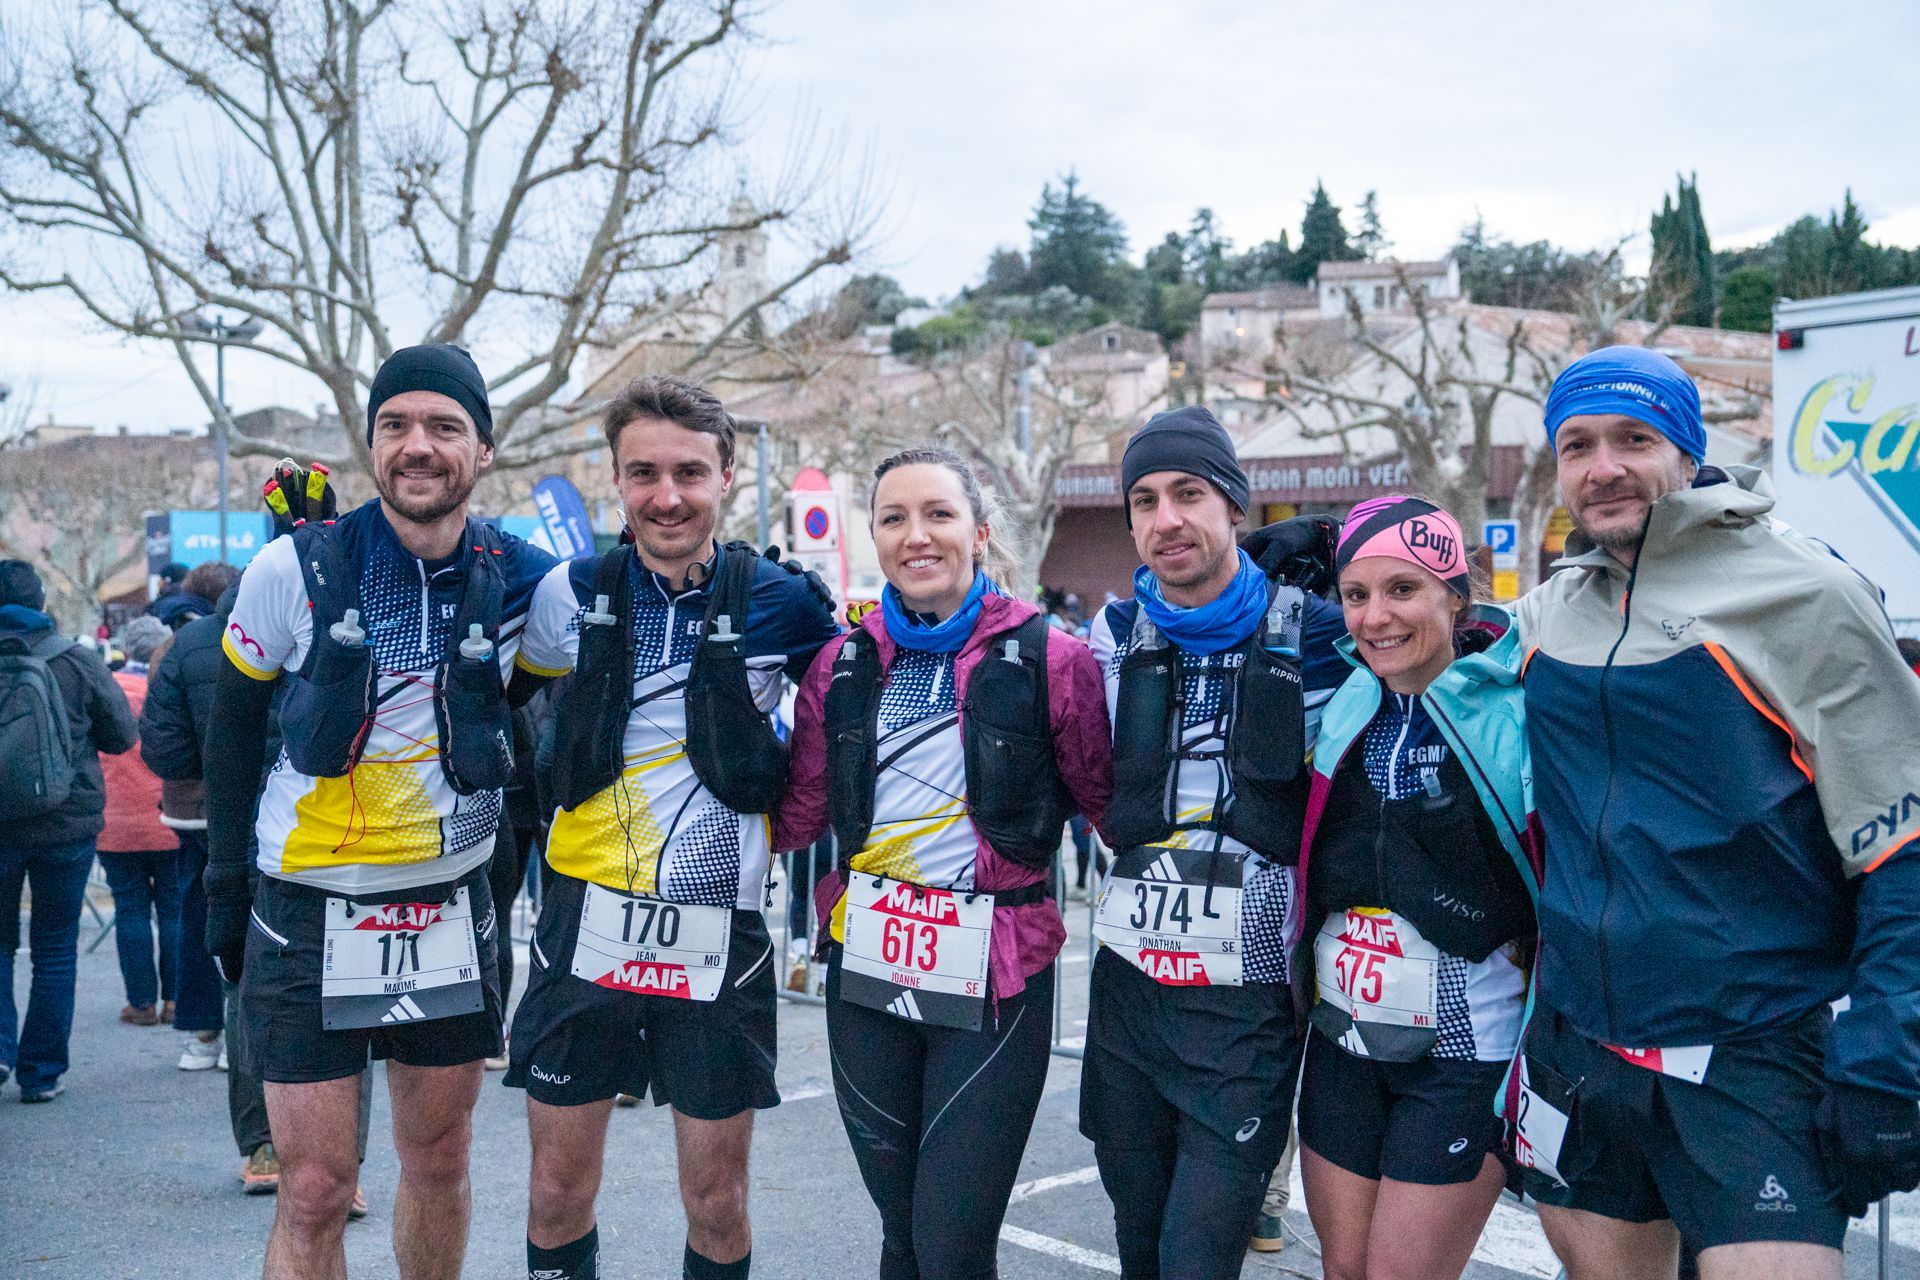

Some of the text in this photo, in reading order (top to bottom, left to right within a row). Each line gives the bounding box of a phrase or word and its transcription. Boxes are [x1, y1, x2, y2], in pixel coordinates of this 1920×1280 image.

[1491, 527, 1509, 552] P
[886, 888, 954, 920] MAIF
[1130, 882, 1193, 934] 374
[621, 900, 681, 948] 170
[635, 950, 657, 962] JEAN
[882, 917, 938, 972] 613
[1138, 936, 1236, 953] JONATHAN SE
[383, 967, 473, 994] MAXIME M1
[612, 964, 687, 991] MAIF
[1136, 953, 1204, 981] MAIF
[891, 971, 979, 995] JOANNE SE
[1414, 1014, 1430, 1026] M1
[531, 1064, 571, 1084] CIMALP
